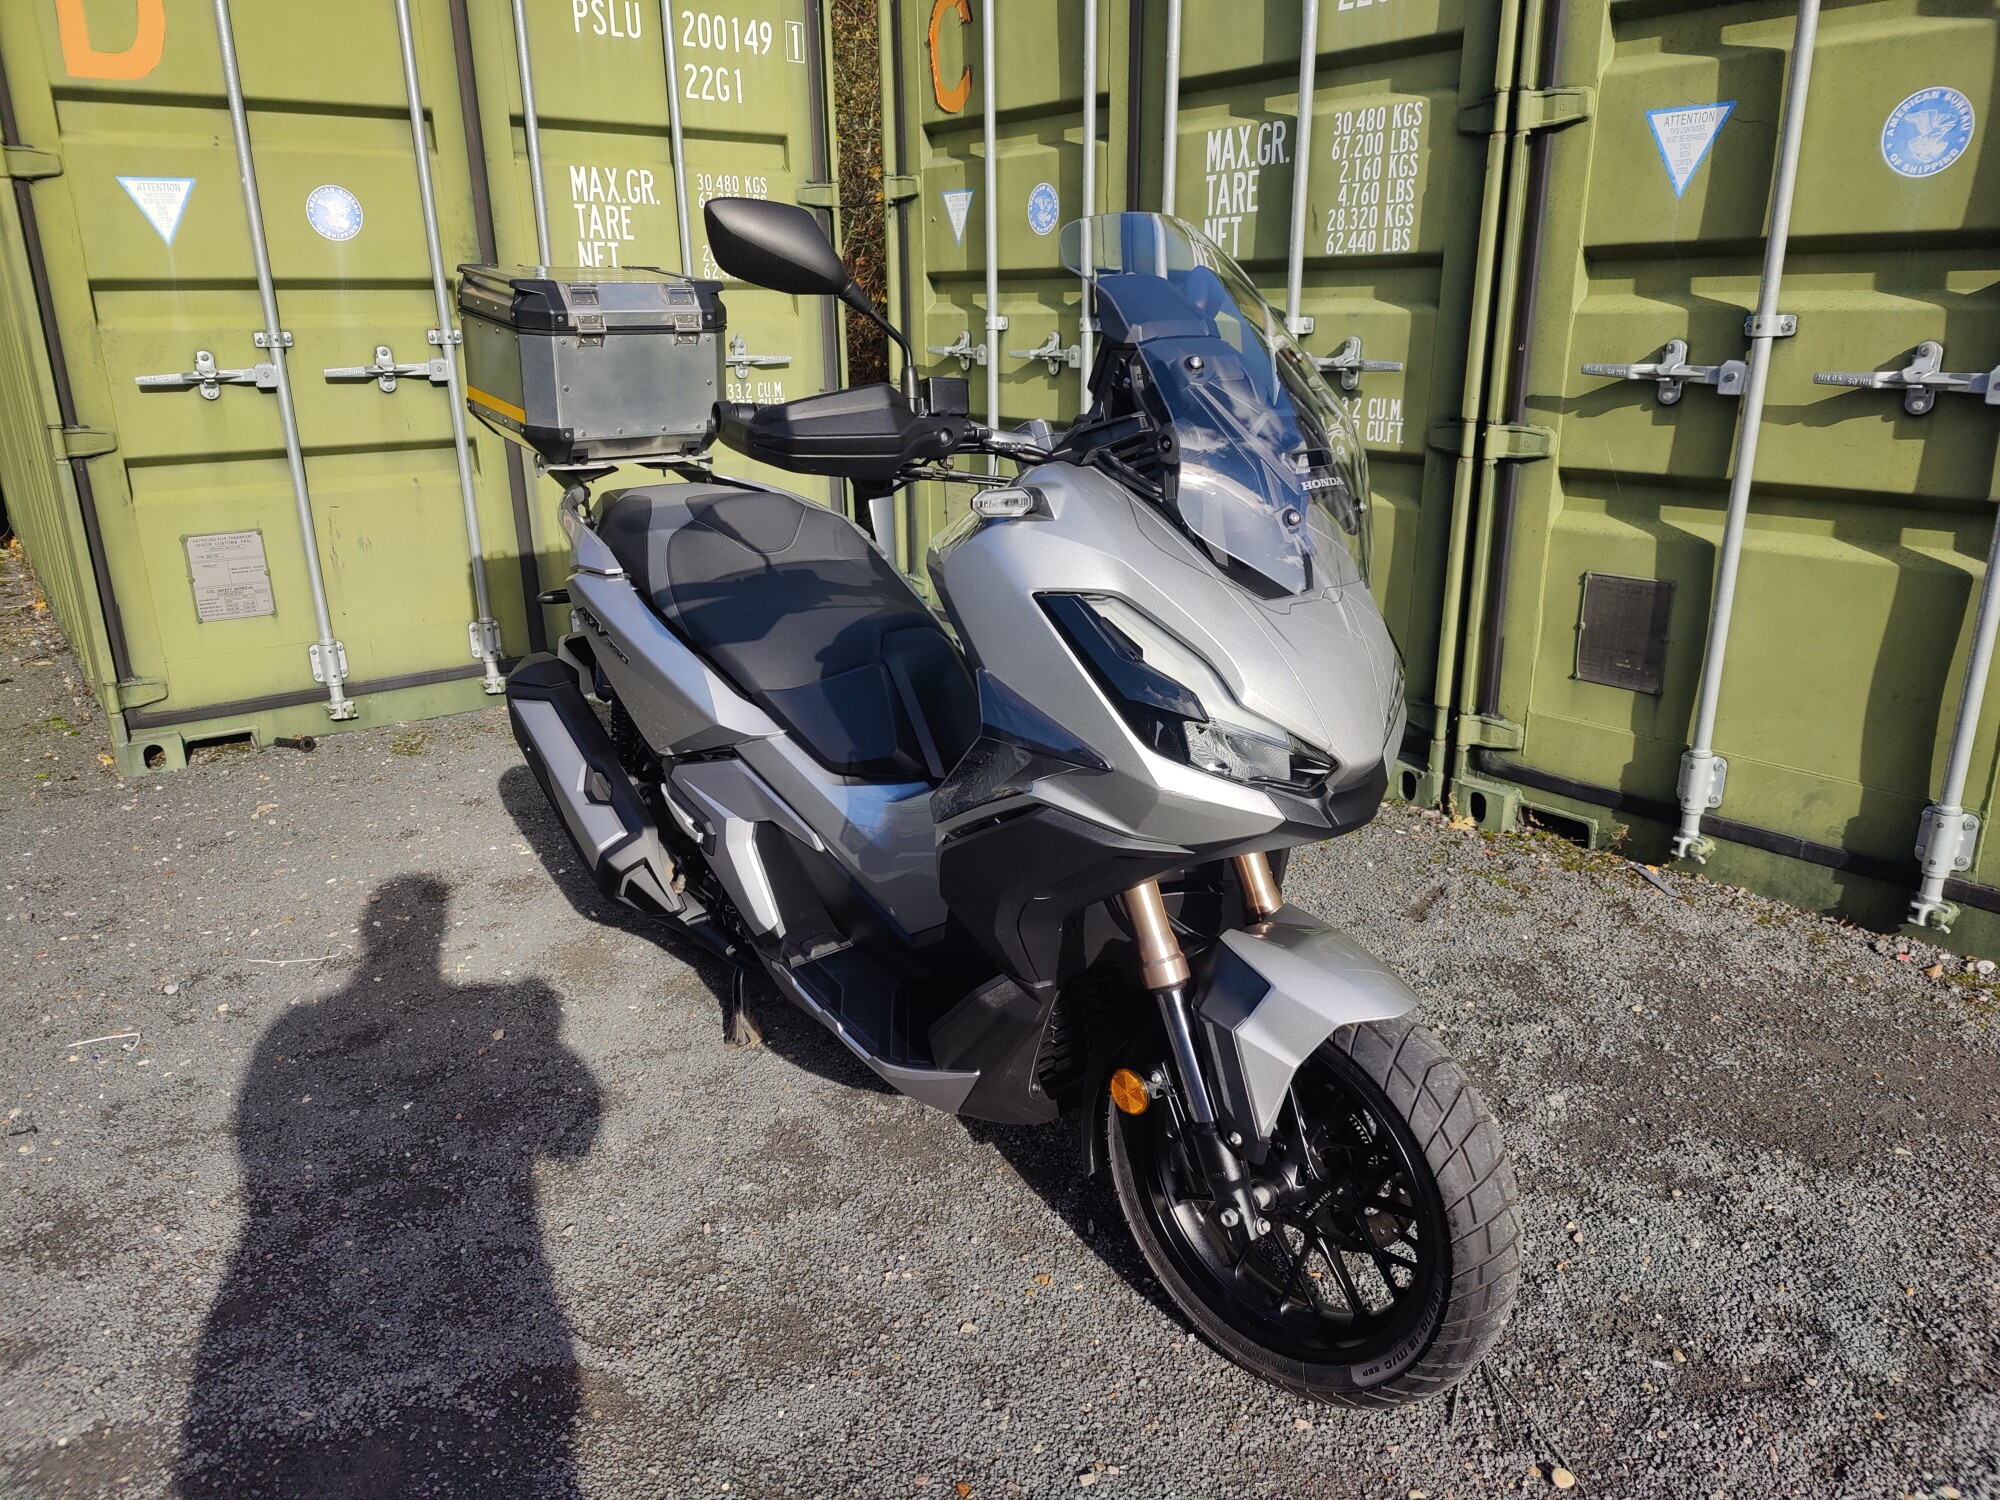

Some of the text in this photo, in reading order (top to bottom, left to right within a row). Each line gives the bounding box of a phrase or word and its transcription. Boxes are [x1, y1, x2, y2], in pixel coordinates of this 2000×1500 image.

[572, 0, 642, 39] PSLU
[681, 10, 773, 56] 200149
[928, 0, 972, 113] C
[683, 63, 744, 104] 22G1
[1663, 110, 1716, 127] ATTENTION
[1887, 91, 1971, 174] AMERICAN BUREAU OF SHIPPING
[1205, 120, 1291, 173] MAX.GR.
[1392, 101, 1423, 129] KGS
[1390, 127, 1419, 155] LBS
[136, 182, 181, 192] ATTENTION
[569, 165, 661, 206] MAX.GR.
[745, 175, 768, 194] KGS
[1205, 169, 1261, 216] TARE
[1387, 153, 1419, 179] KGS
[1386, 178, 1415, 204] LBS
[309, 187, 361, 239] AMERICAN BUREAU OF SHIPPING
[573, 203, 635, 241] TARE
[1384, 203, 1414, 229] KGS
[1382, 228, 1411, 253] LBS
[727, 381, 786, 400] 33.2 CU.M.
[1367, 397, 1404, 422] CU.M.
[1366, 420, 1404, 444] CU.FT.
[1300, 476, 1345, 491] HONDA
[576, 606, 612, 638] ADV
